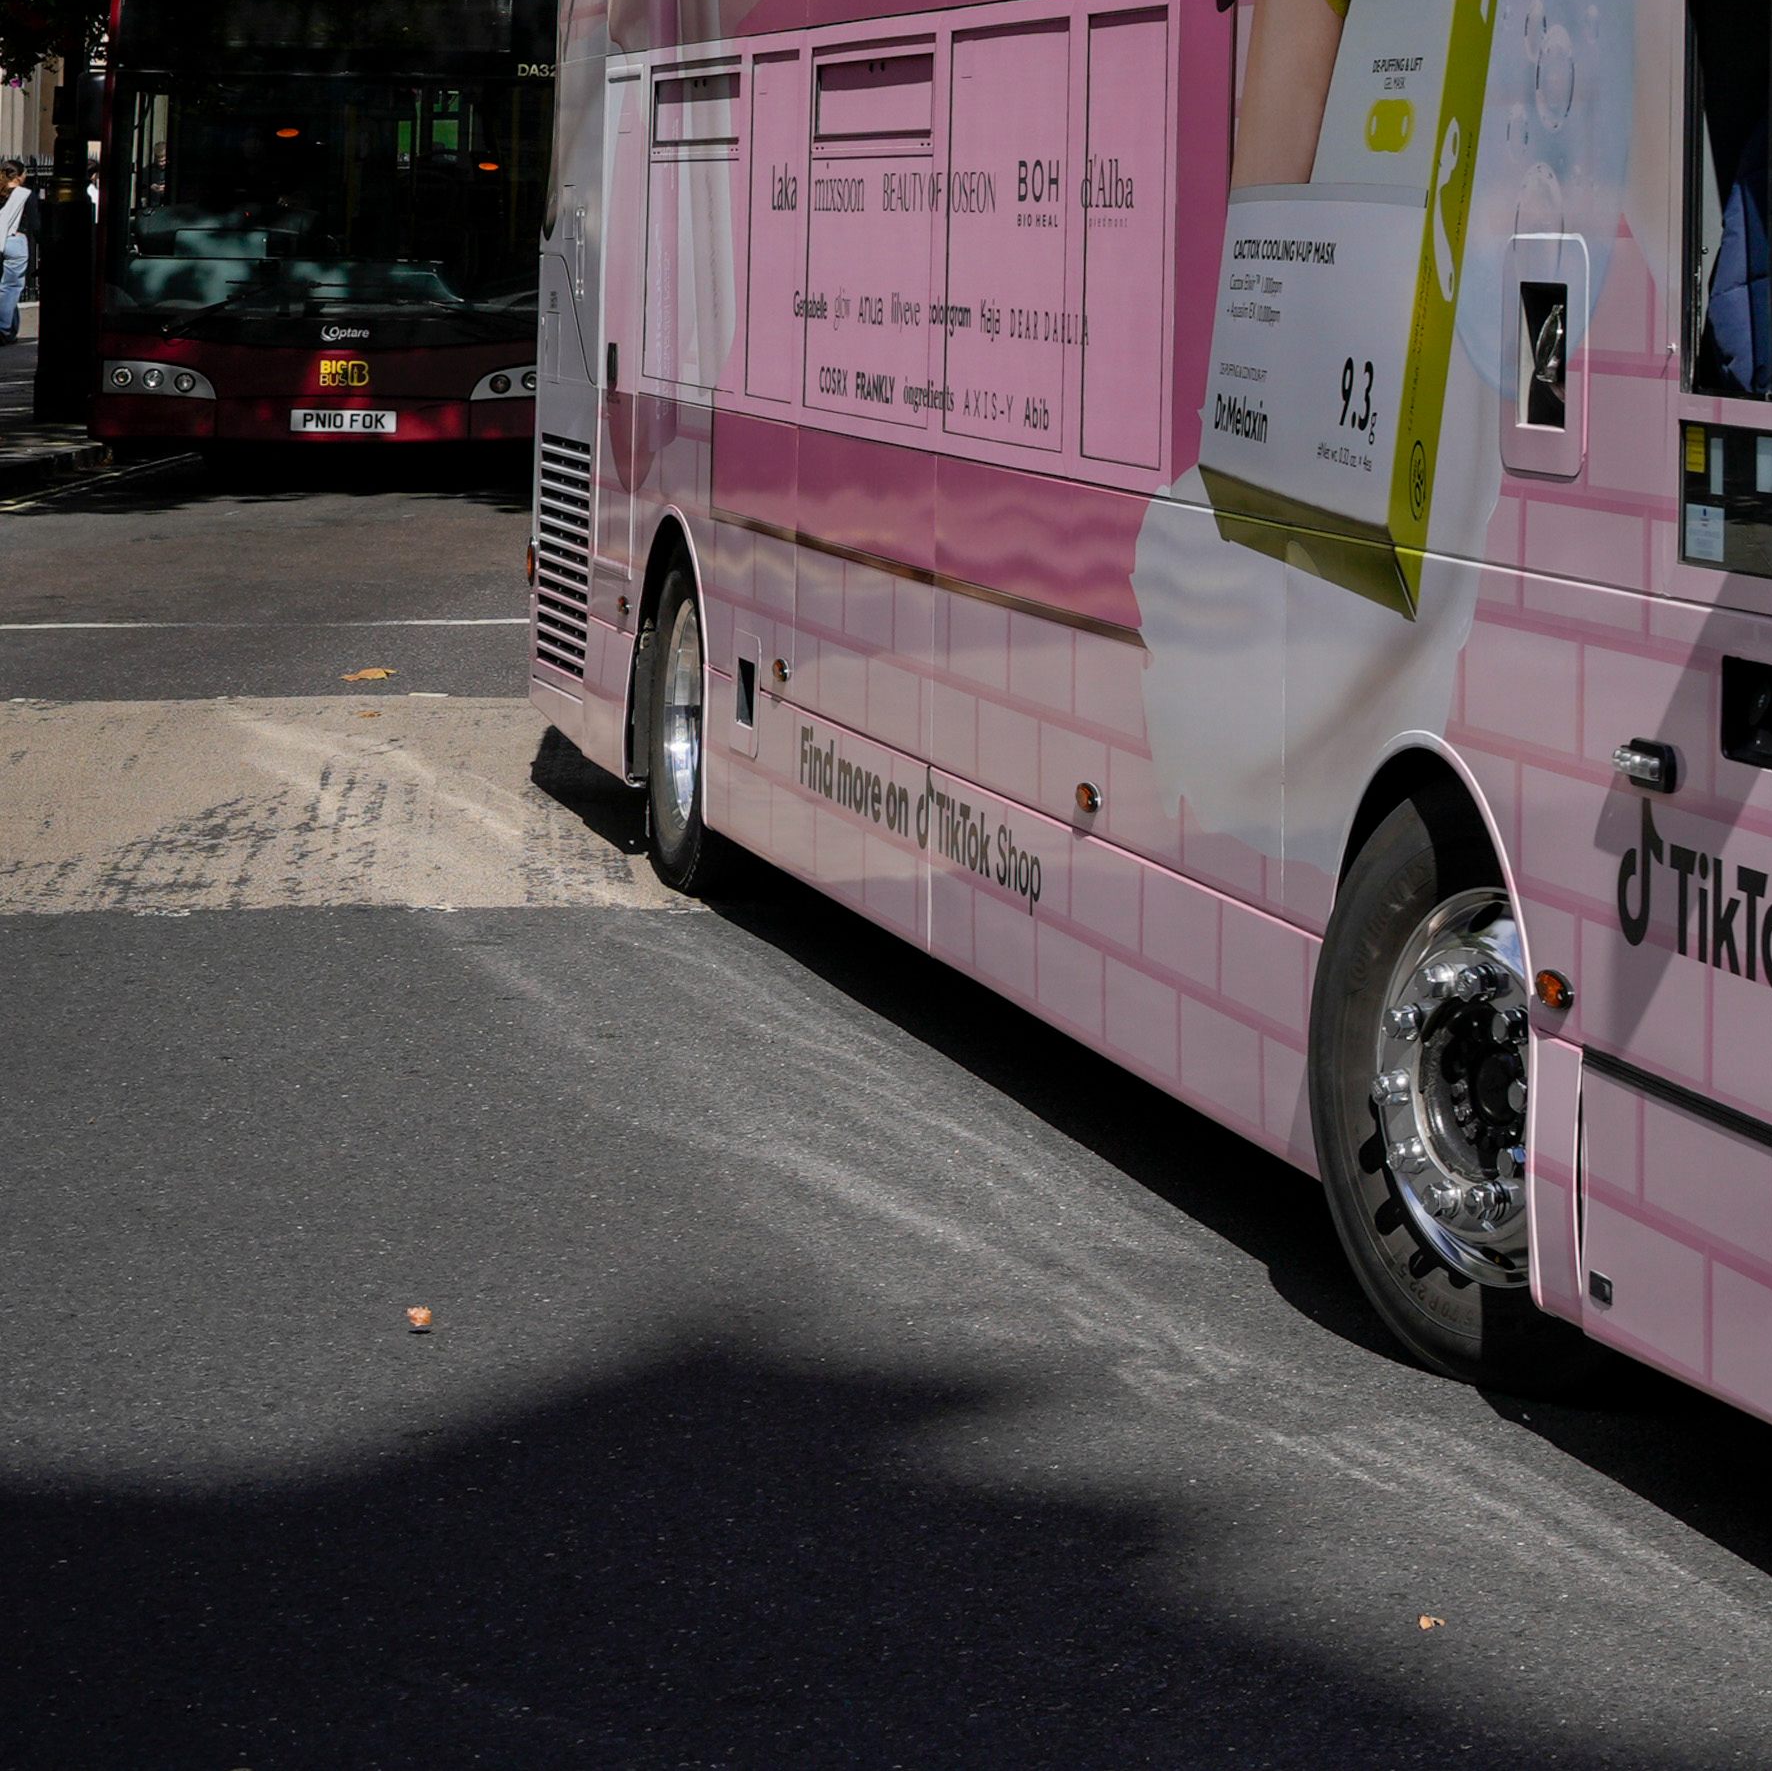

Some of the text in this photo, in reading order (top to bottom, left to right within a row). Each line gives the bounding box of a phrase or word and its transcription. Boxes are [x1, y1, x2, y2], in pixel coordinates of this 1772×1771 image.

[771, 164, 797, 211] Laka
[813, 162, 865, 213] mixsoon
[882, 172, 926, 213] BEAUTY
[928, 172, 943, 214] OF
[1016, 159, 1061, 204] BOH
[1080, 154, 1135, 210] d'Alba
[1016, 212, 1034, 227] BIO
[1035, 213, 1059, 228] HEAL
[1233, 239, 1262, 261] CACTOX
[1261, 239, 1297, 262] COOLING
[1312, 241, 1337, 266] MASK
[328, 325, 370, 340] Optare
[979, 297, 1002, 342] Kaja
[1009, 308, 1040, 341] DEAR
[319, 373, 348, 387] BUS
[320, 359, 348, 374] BIG
[819, 365, 849, 397] COSRX
[854, 371, 896, 405] FRANKLY
[963, 388, 1014, 424] AXIS-Y
[1024, 397, 1050, 431] Abib
[302, 412, 387, 430] PN10 FOK
[1214, 393, 1269, 444] Dr.Melaxin
[800, 726, 1042, 918] Find more on TikTok Shop
